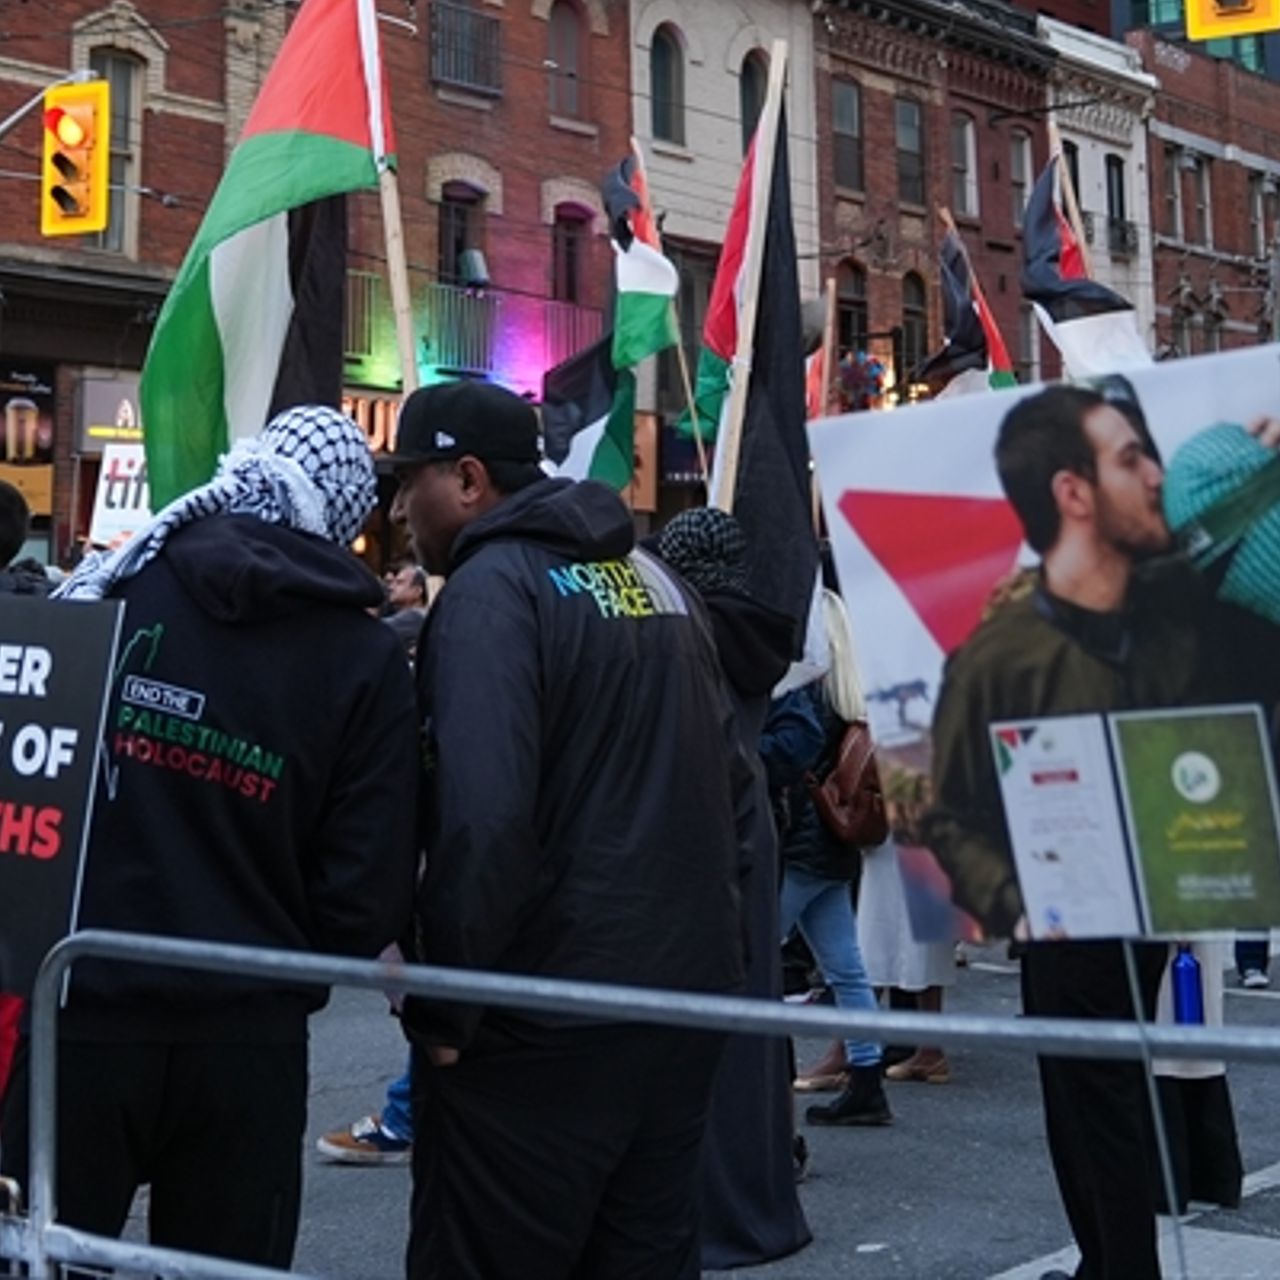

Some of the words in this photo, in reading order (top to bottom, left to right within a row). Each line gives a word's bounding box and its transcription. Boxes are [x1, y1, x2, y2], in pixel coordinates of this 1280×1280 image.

[548, 558, 642, 597] NORTH
[592, 587, 655, 620] FACE
[130, 680, 161, 703] END
[162, 690, 190, 713] THE
[12, 724, 77, 778] OF
[117, 706, 285, 780] PALESTINIAN
[115, 731, 276, 803] HOLOCAUST
